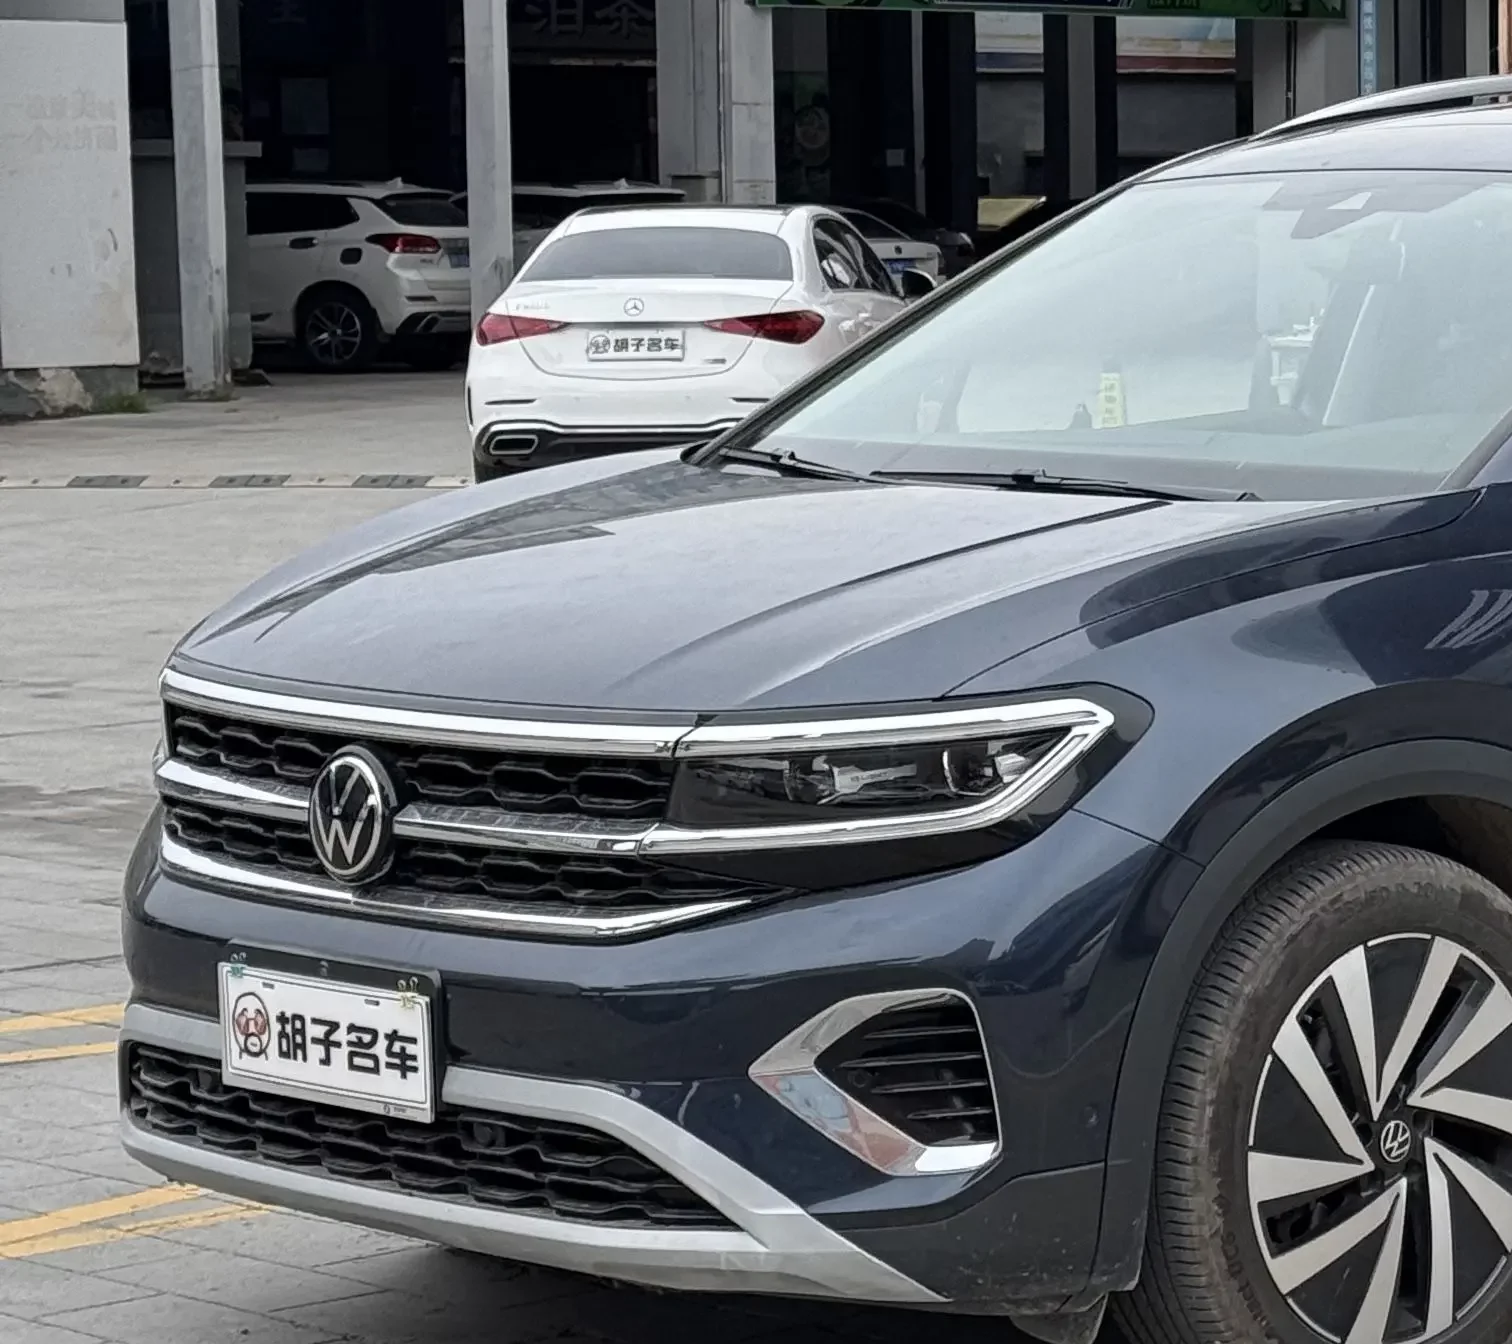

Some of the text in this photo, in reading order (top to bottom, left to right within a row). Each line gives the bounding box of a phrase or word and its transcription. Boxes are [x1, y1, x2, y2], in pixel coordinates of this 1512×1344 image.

[613, 338, 681, 353] 胡子名车
[275, 1010, 419, 1080] 胡子名车
